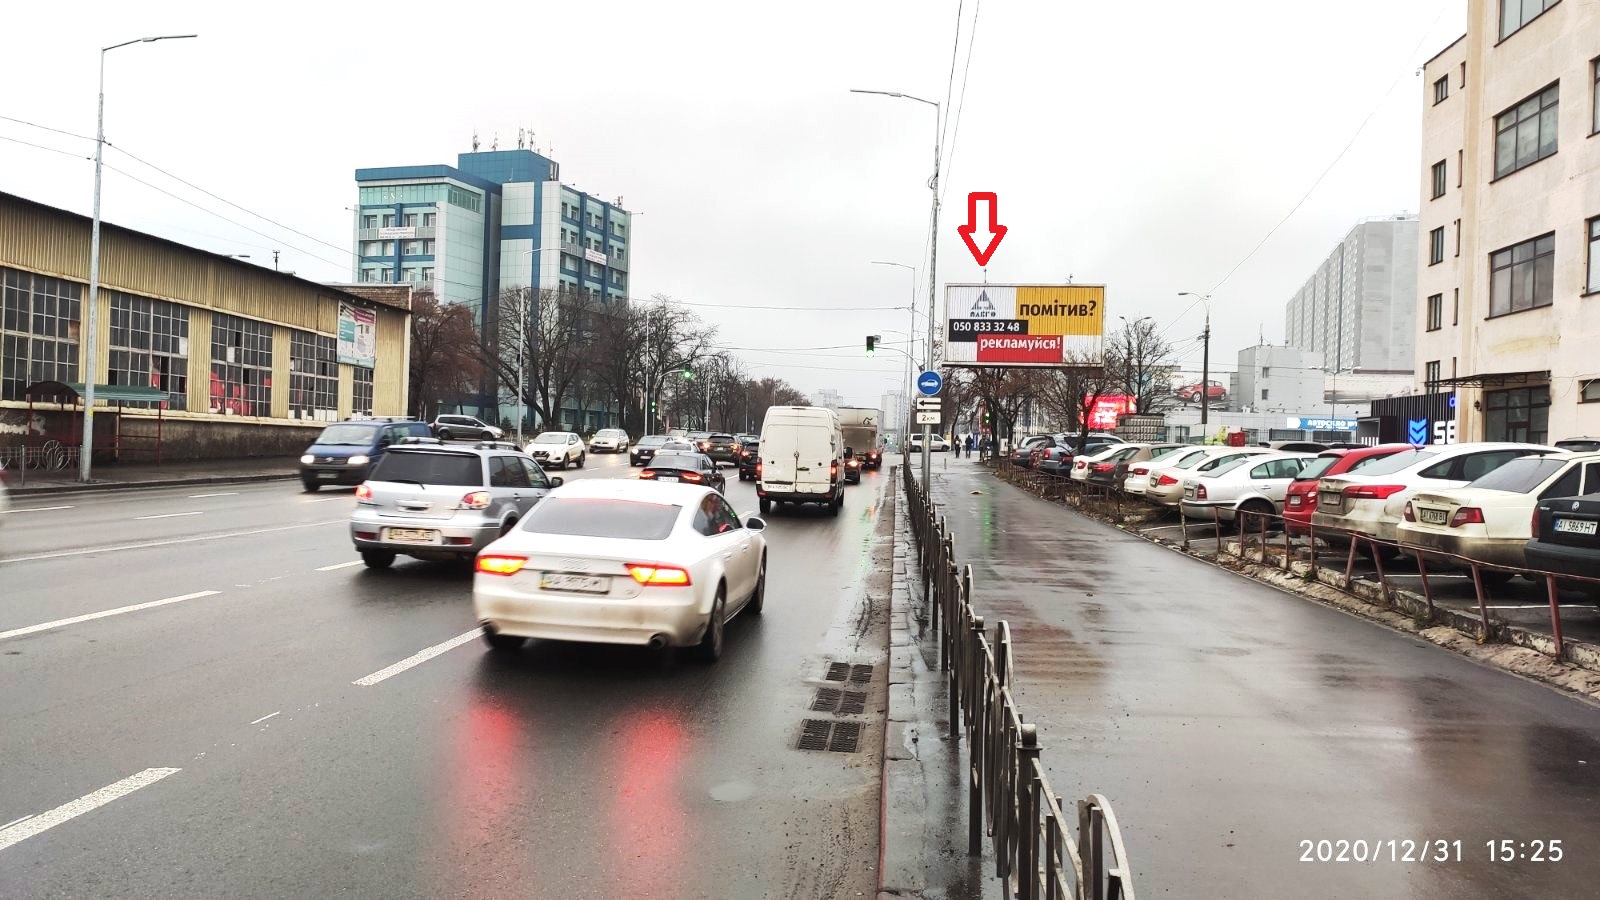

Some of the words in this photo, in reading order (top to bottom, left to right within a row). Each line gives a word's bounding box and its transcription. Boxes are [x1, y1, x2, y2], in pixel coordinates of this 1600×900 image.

[1019, 300, 1097, 317] помітив?
[953, 321, 971, 332] 050
[973, 321, 991, 332] 833
[993, 321, 1005, 332] 32
[1007, 322, 1020, 332] 48
[980, 336, 1061, 352] рекламуйся!
